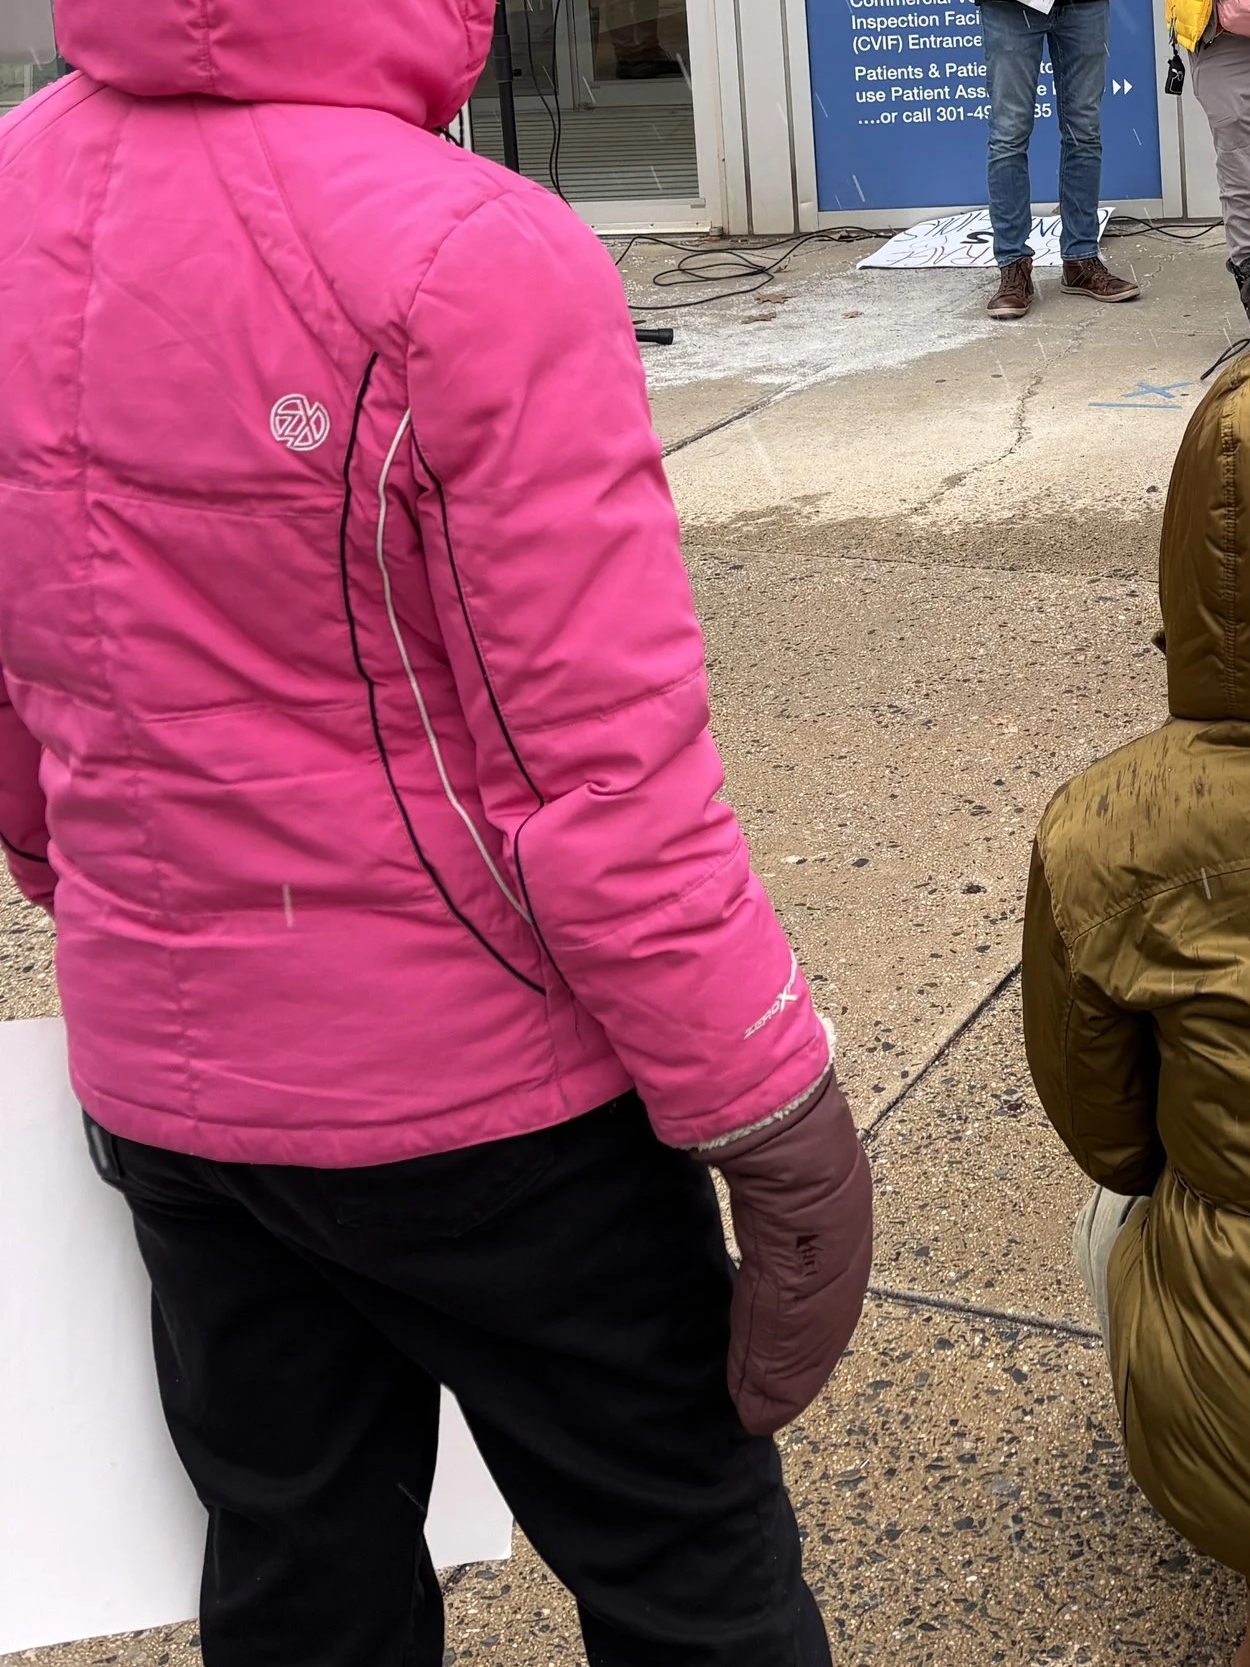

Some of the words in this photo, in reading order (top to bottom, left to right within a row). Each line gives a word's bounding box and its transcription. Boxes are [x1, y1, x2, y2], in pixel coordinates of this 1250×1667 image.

[852, 13, 939, 32] Inspection
[853, 35, 903, 54] (CVIF)
[908, 34, 982, 49] Entrance
[854, 63, 925, 81] Patients
[928, 64, 940, 78] &
[856, 90, 886, 103] use
[891, 85, 950, 102] Patient
[903, 108, 931, 123] call
